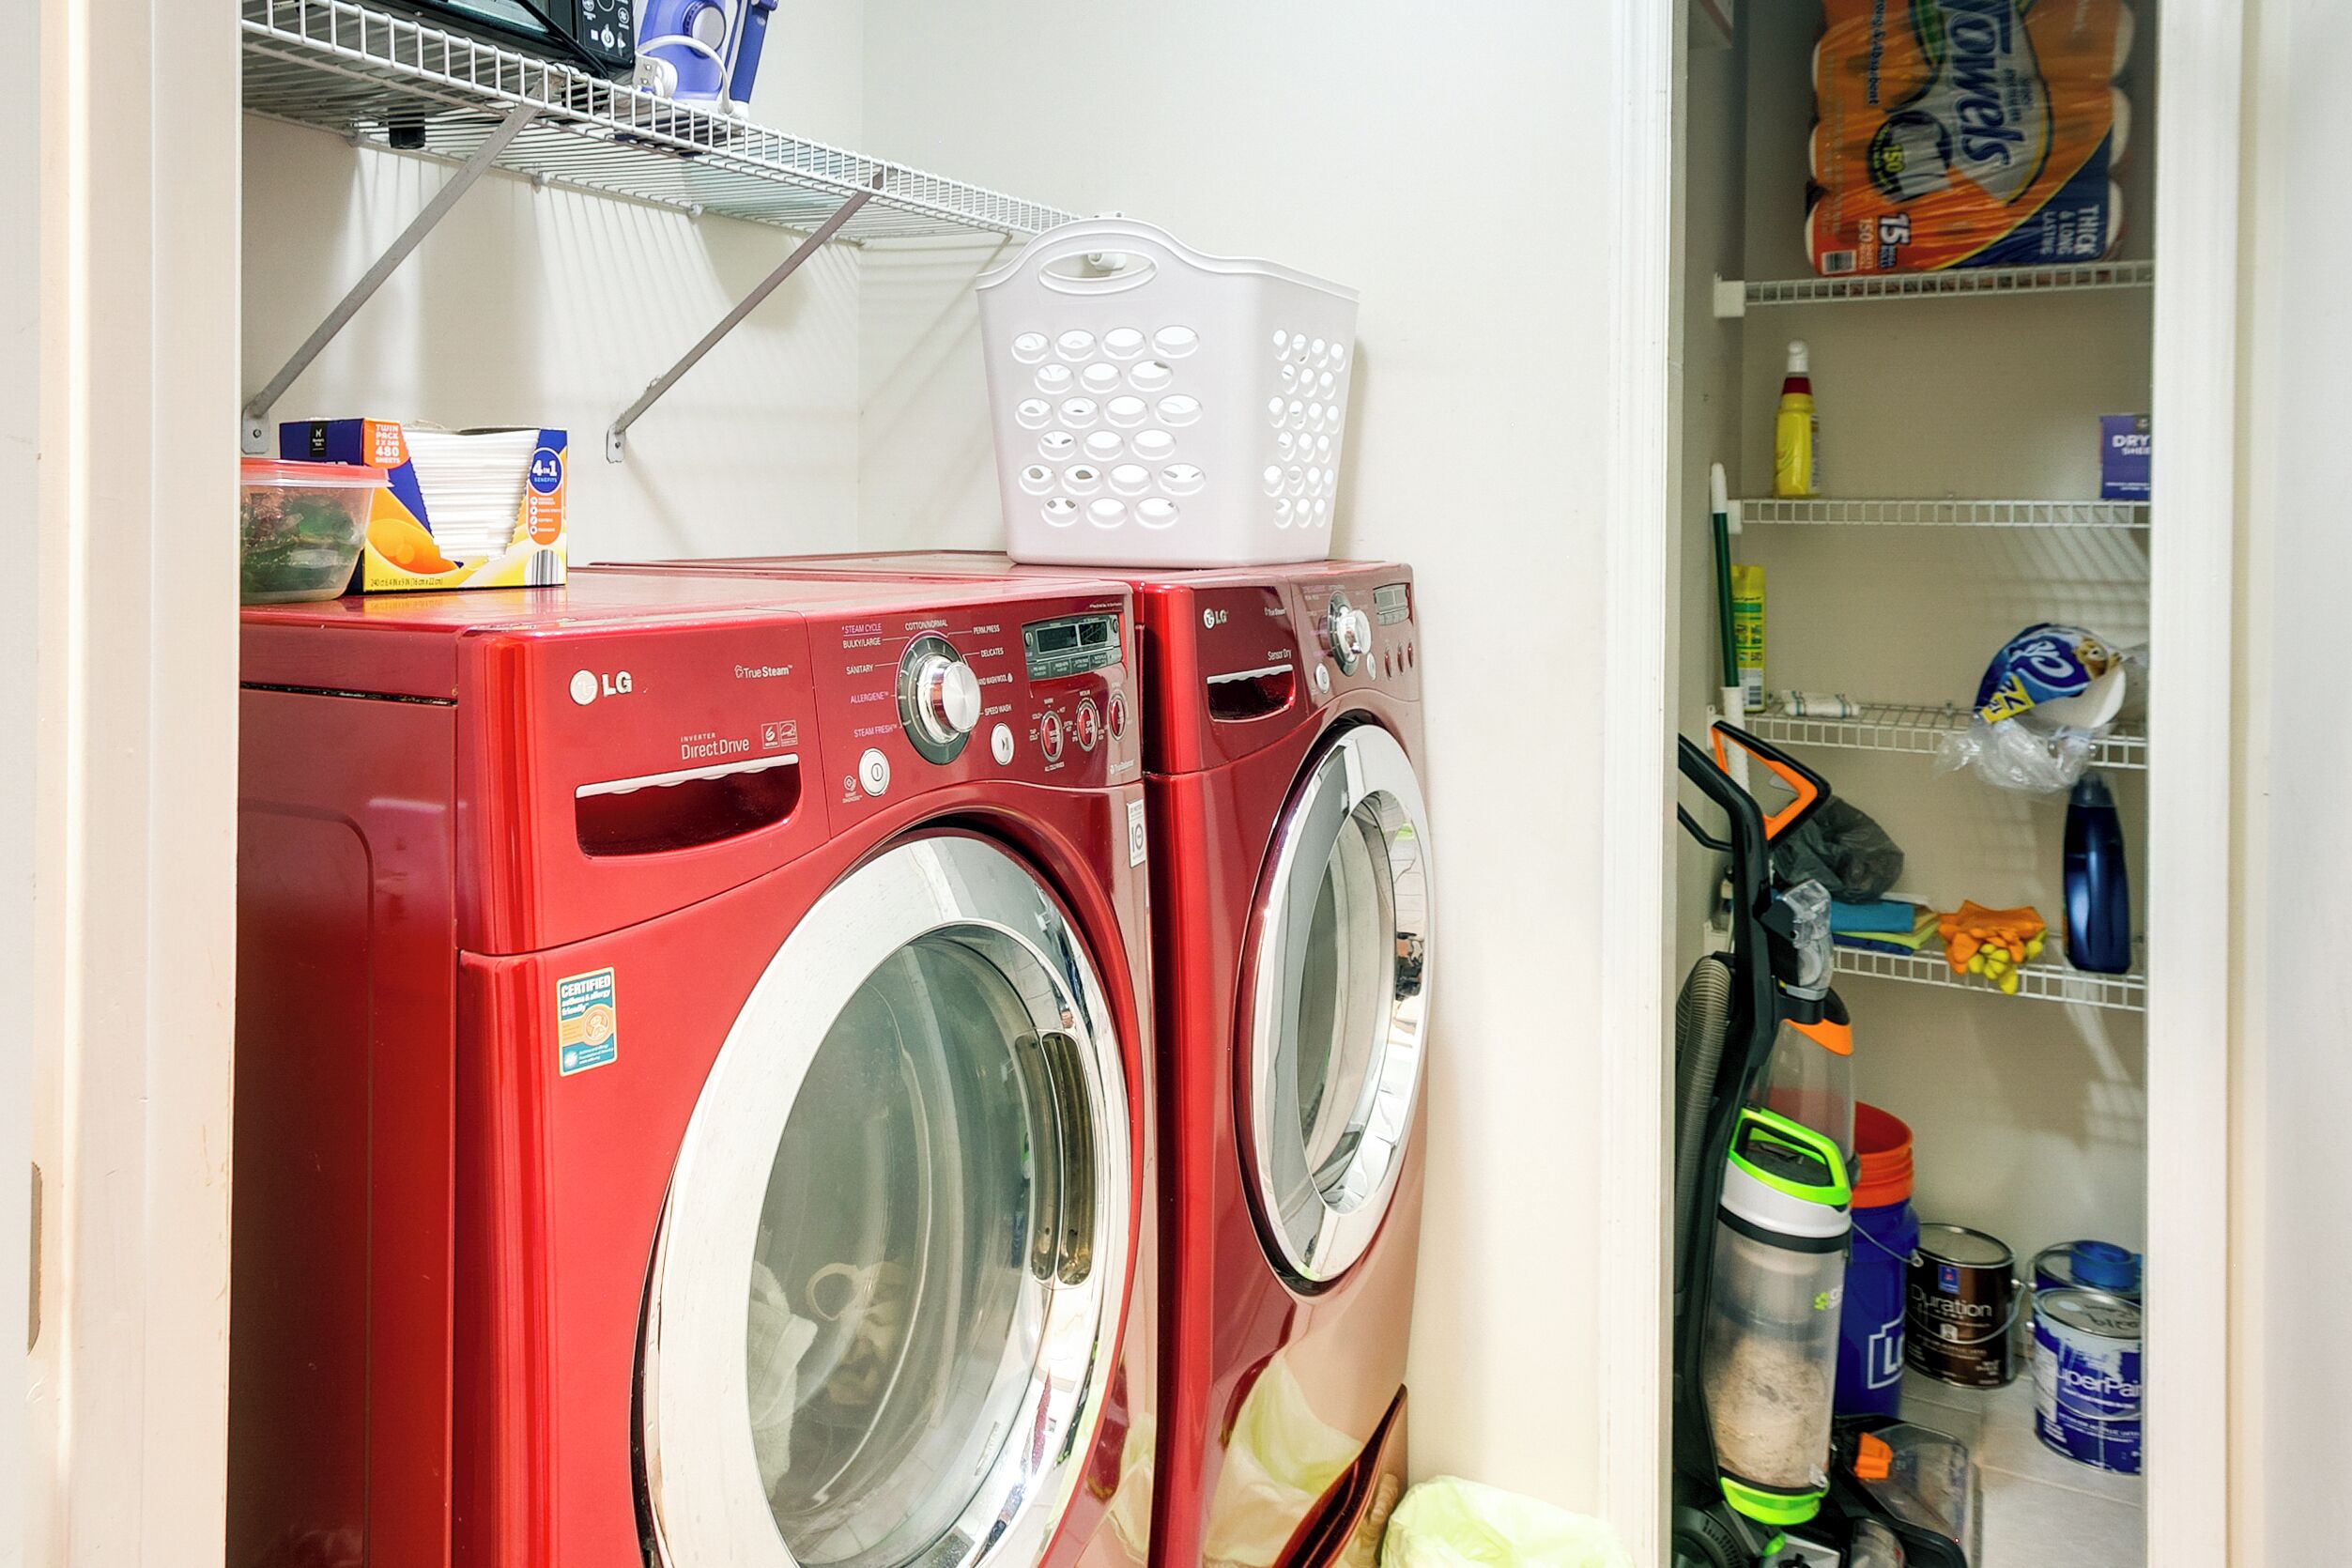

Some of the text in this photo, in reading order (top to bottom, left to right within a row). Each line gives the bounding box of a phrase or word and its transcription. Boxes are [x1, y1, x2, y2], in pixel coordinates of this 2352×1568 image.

[1858, 219, 1874, 242] 150
[1880, 213, 1910, 243] 15
[2073, 204, 2100, 255] THICK
[2056, 223, 2076, 255] LONG
[376, 423, 399, 432] TWIN
[376, 431, 399, 439] PACK
[376, 446, 399, 456] 480
[865, 623, 882, 632] CYCLE
[843, 638, 882, 649] BULKY/LARGE
[980, 647, 1005, 657] DELICATES
[1268, 648, 1292, 661] Sensor Dry
[846, 664, 874, 675] SANITARY
[601, 670, 633, 699] LG
[680, 732, 716, 743] INVERTER
[853, 727, 874, 738] STEAM
[681, 738, 749, 760] Direct Drive
[561, 974, 611, 998] CERTIFIED
[1911, 1284, 1992, 1317] Duration
